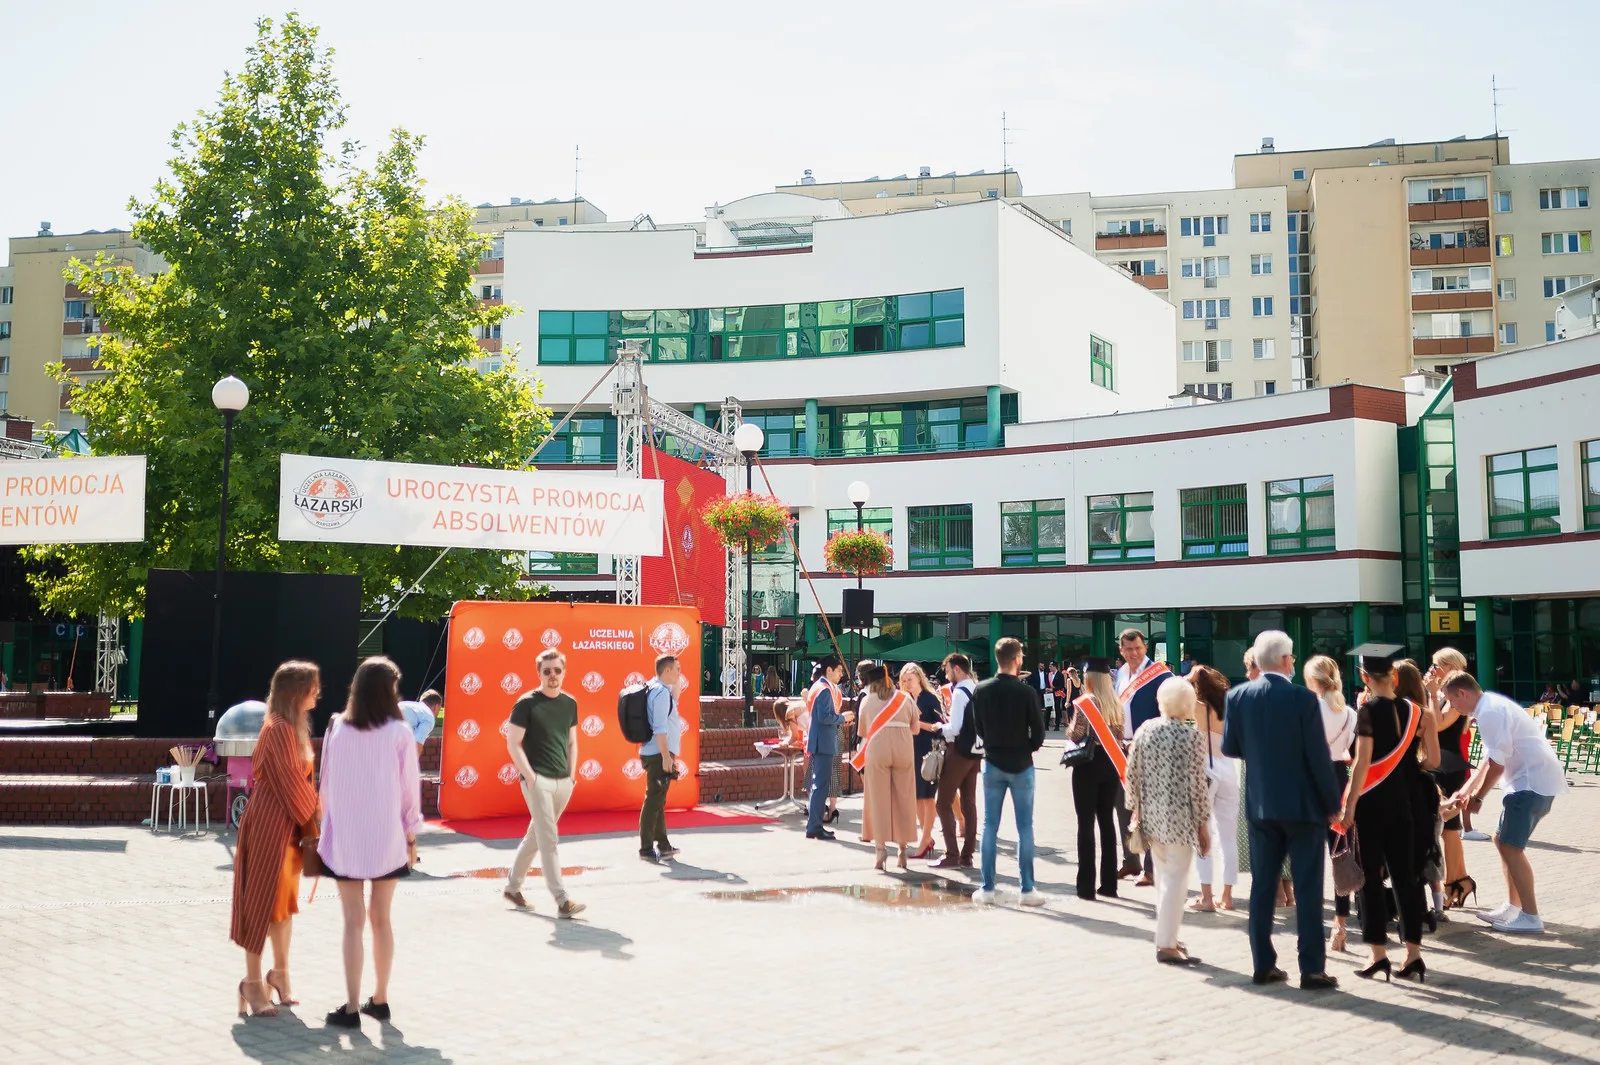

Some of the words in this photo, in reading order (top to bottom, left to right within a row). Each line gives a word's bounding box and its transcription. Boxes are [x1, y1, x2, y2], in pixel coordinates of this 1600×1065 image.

[5, 473, 124, 497] PROMOCJA
[302, 473, 323, 493] UCZELNIA
[324, 472, 356, 496] ŁAZARSKIEGO
[387, 478, 520, 505] UROCZYSTA
[532, 487, 646, 513] PROMOCJA
[294, 494, 363, 513] ŁAZARSKI
[432, 510, 605, 537] ABSOLWENTÓW
[761, 620, 770, 630] D
[1439, 616, 1451, 630] E
[55, 624, 66, 636] C
[76, 625, 85, 636] C
[589, 629, 635, 639] UCZELNIA
[572, 640, 635, 650] ŁAZARSKIEGO
[649, 637, 690, 650] ŁAZARSKI
